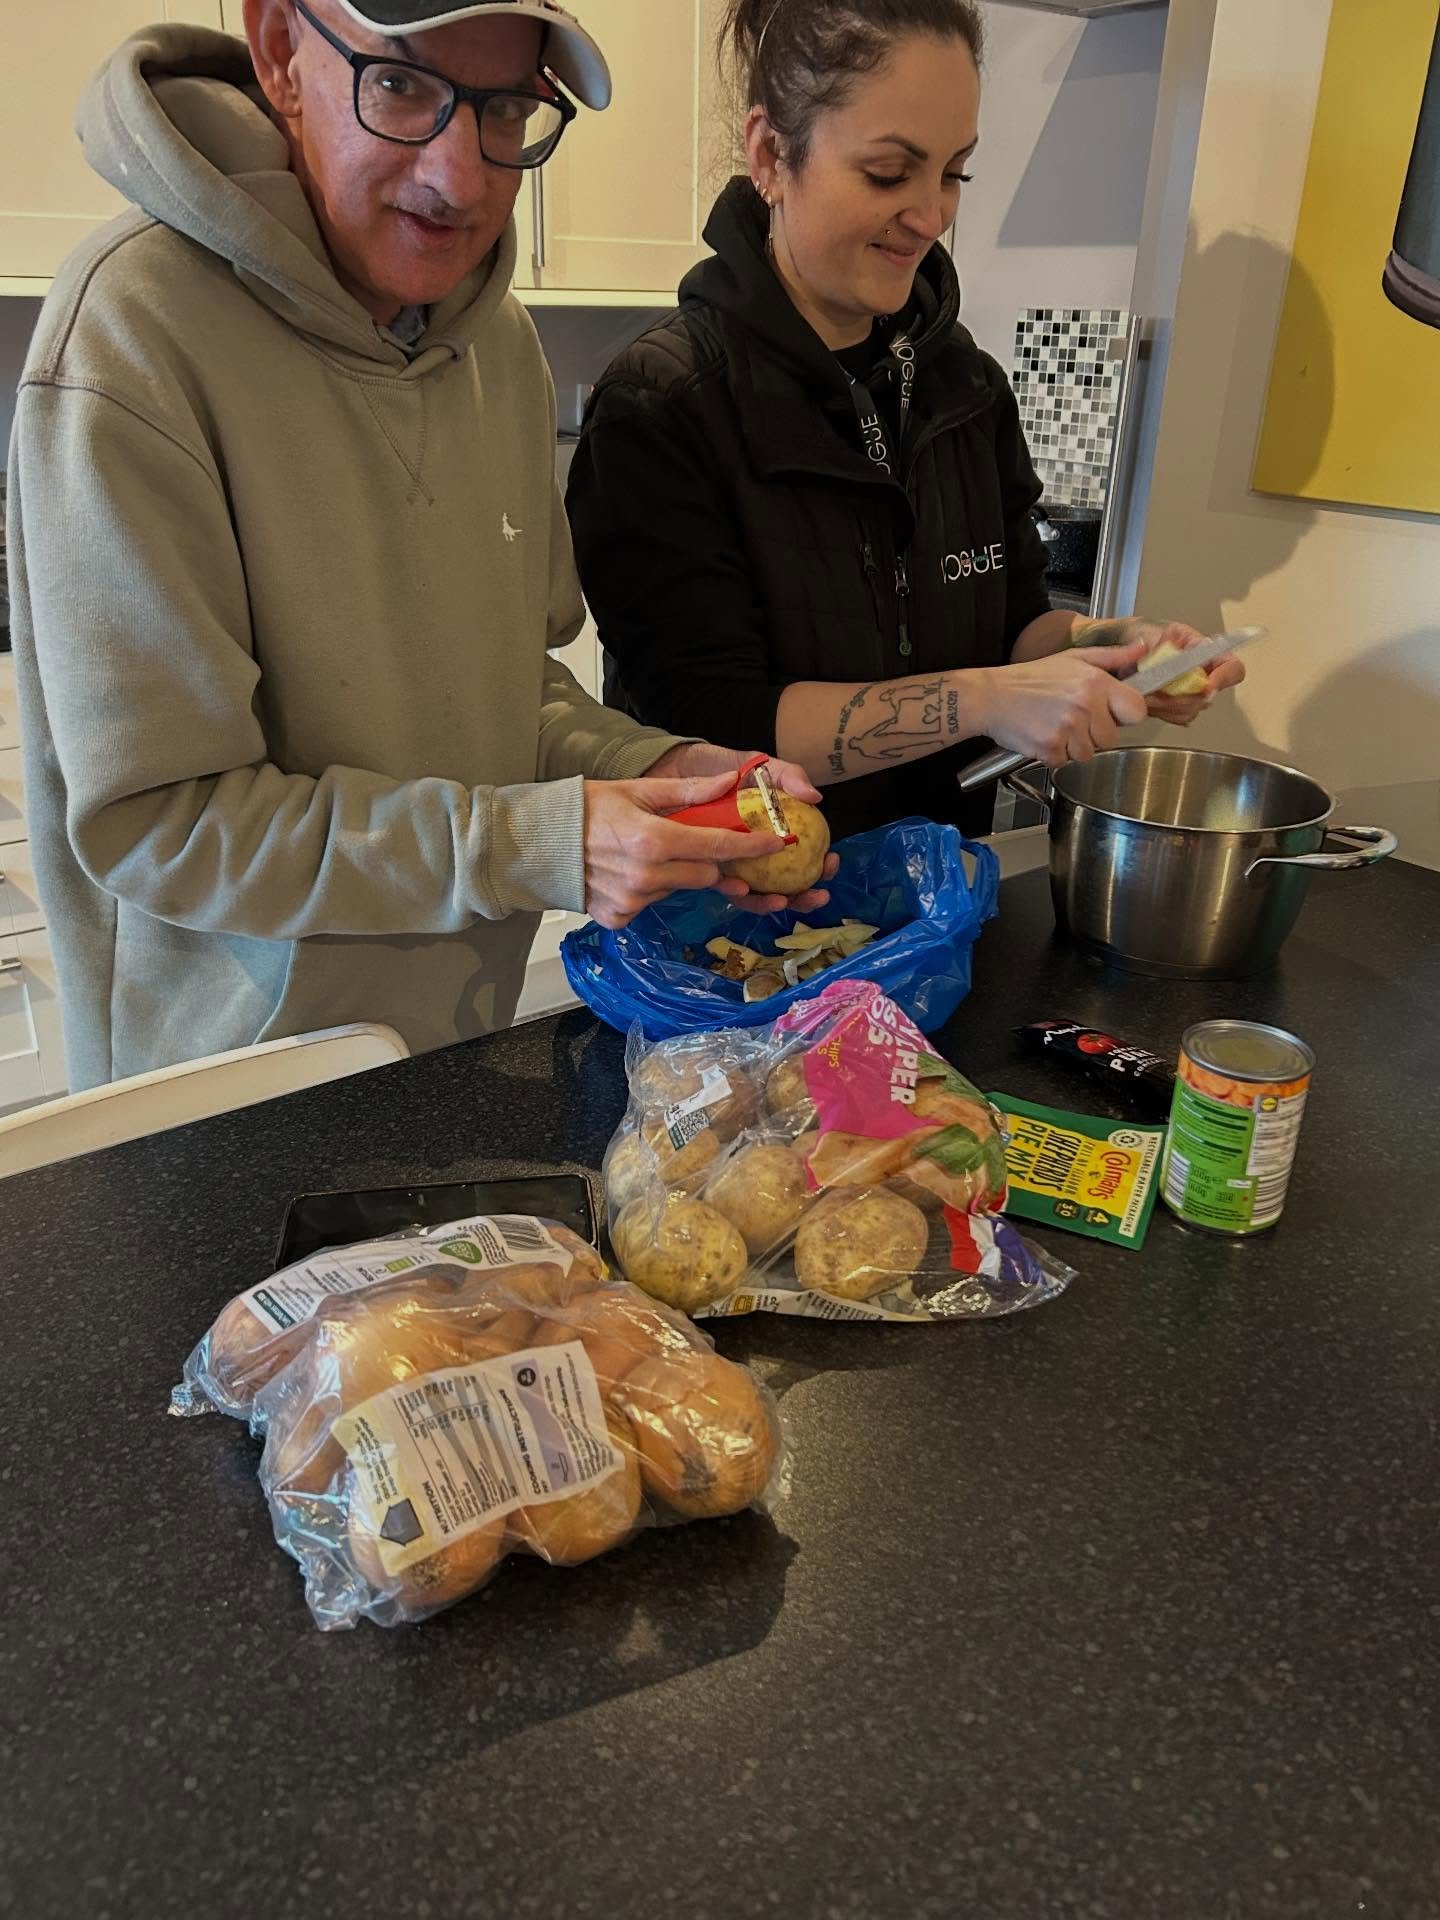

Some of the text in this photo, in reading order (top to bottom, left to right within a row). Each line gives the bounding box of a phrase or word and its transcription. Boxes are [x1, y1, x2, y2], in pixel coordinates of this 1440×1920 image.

[892, 336, 914, 408] VOGUE
[1004, 1121, 1046, 1180] PIE MIX
[1140, 1136, 1158, 1175] RECYCLABLE
[1087, 1151, 1131, 1200] Colman's
[1133, 1176, 1146, 1198] PAPER
[1059, 1203, 1073, 1217] 30
[1094, 1211, 1110, 1226] 4
[422, 1481, 450, 1534] NUTRITION
